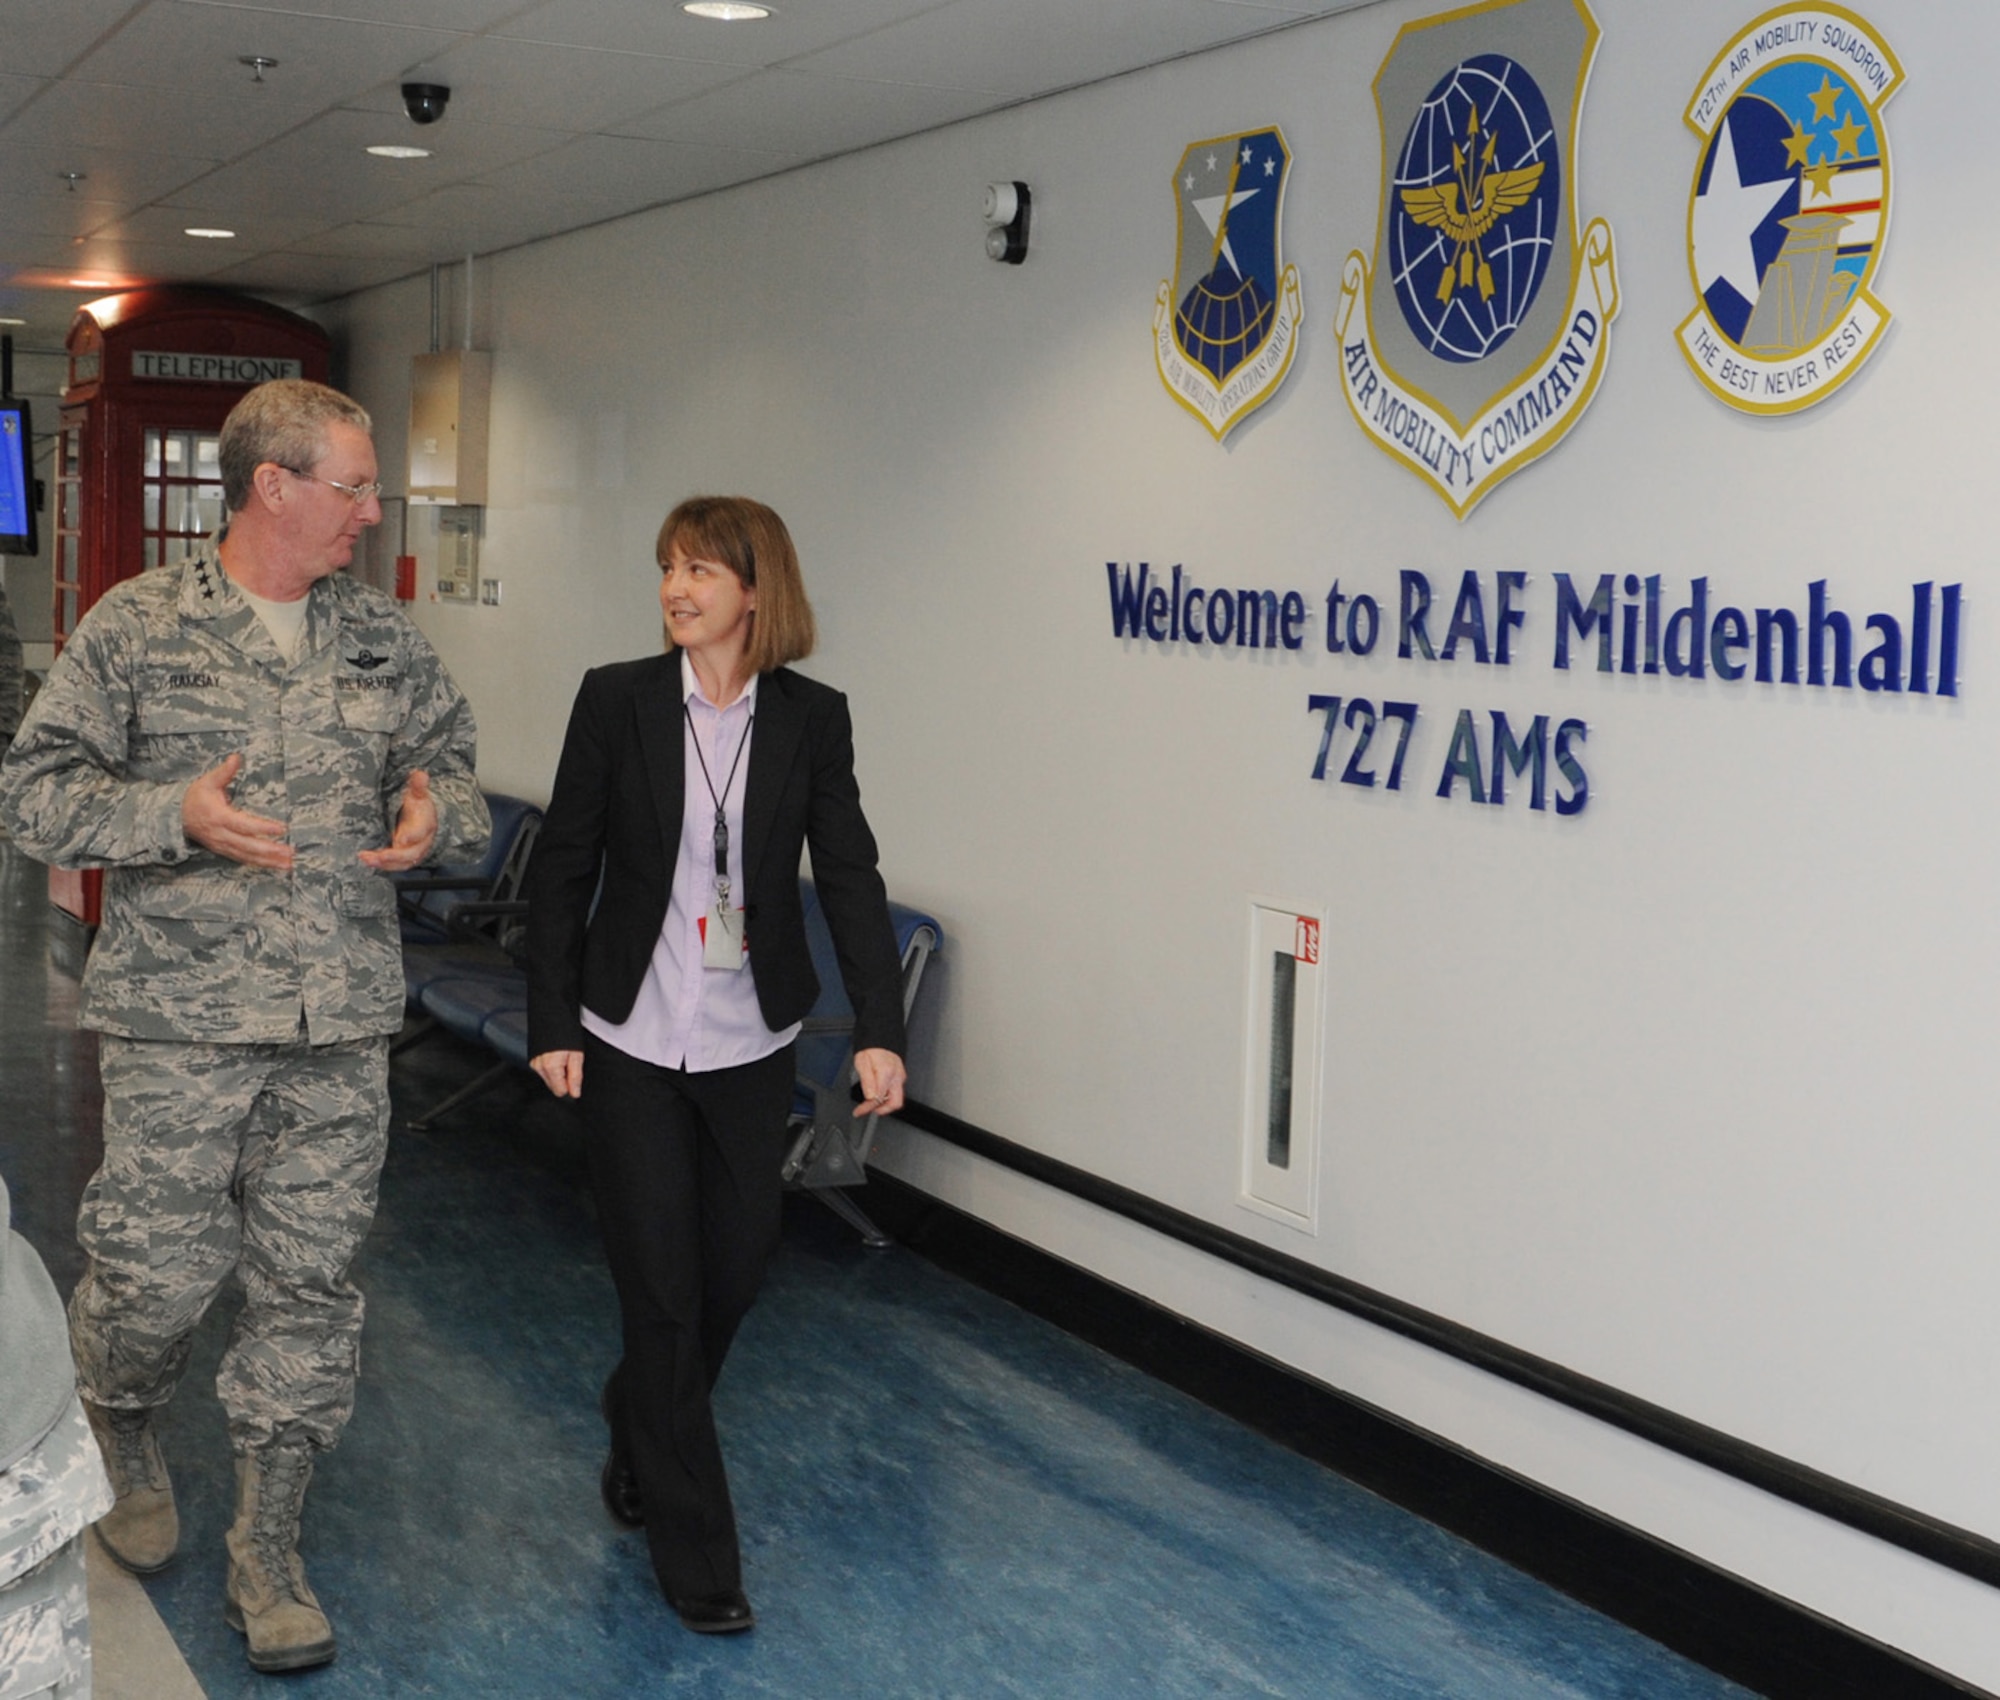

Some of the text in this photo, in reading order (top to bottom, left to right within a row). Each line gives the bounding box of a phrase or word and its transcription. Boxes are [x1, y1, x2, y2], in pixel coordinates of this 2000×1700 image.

[1729, 48, 1751, 79] AIR
[1754, 21, 1818, 57] MOBILITY
[1821, 24, 1888, 92] SQUADRON
[138, 354, 293, 381] TELEPHONE
[1345, 308, 1598, 488] AIR MOBILITY COMMAND
[1693, 316, 1864, 395] THE BEST NEVER REST
[1106, 562, 1963, 697] Welcome to RAF Mildenhall
[1308, 694, 1589, 816] 727 AMS
